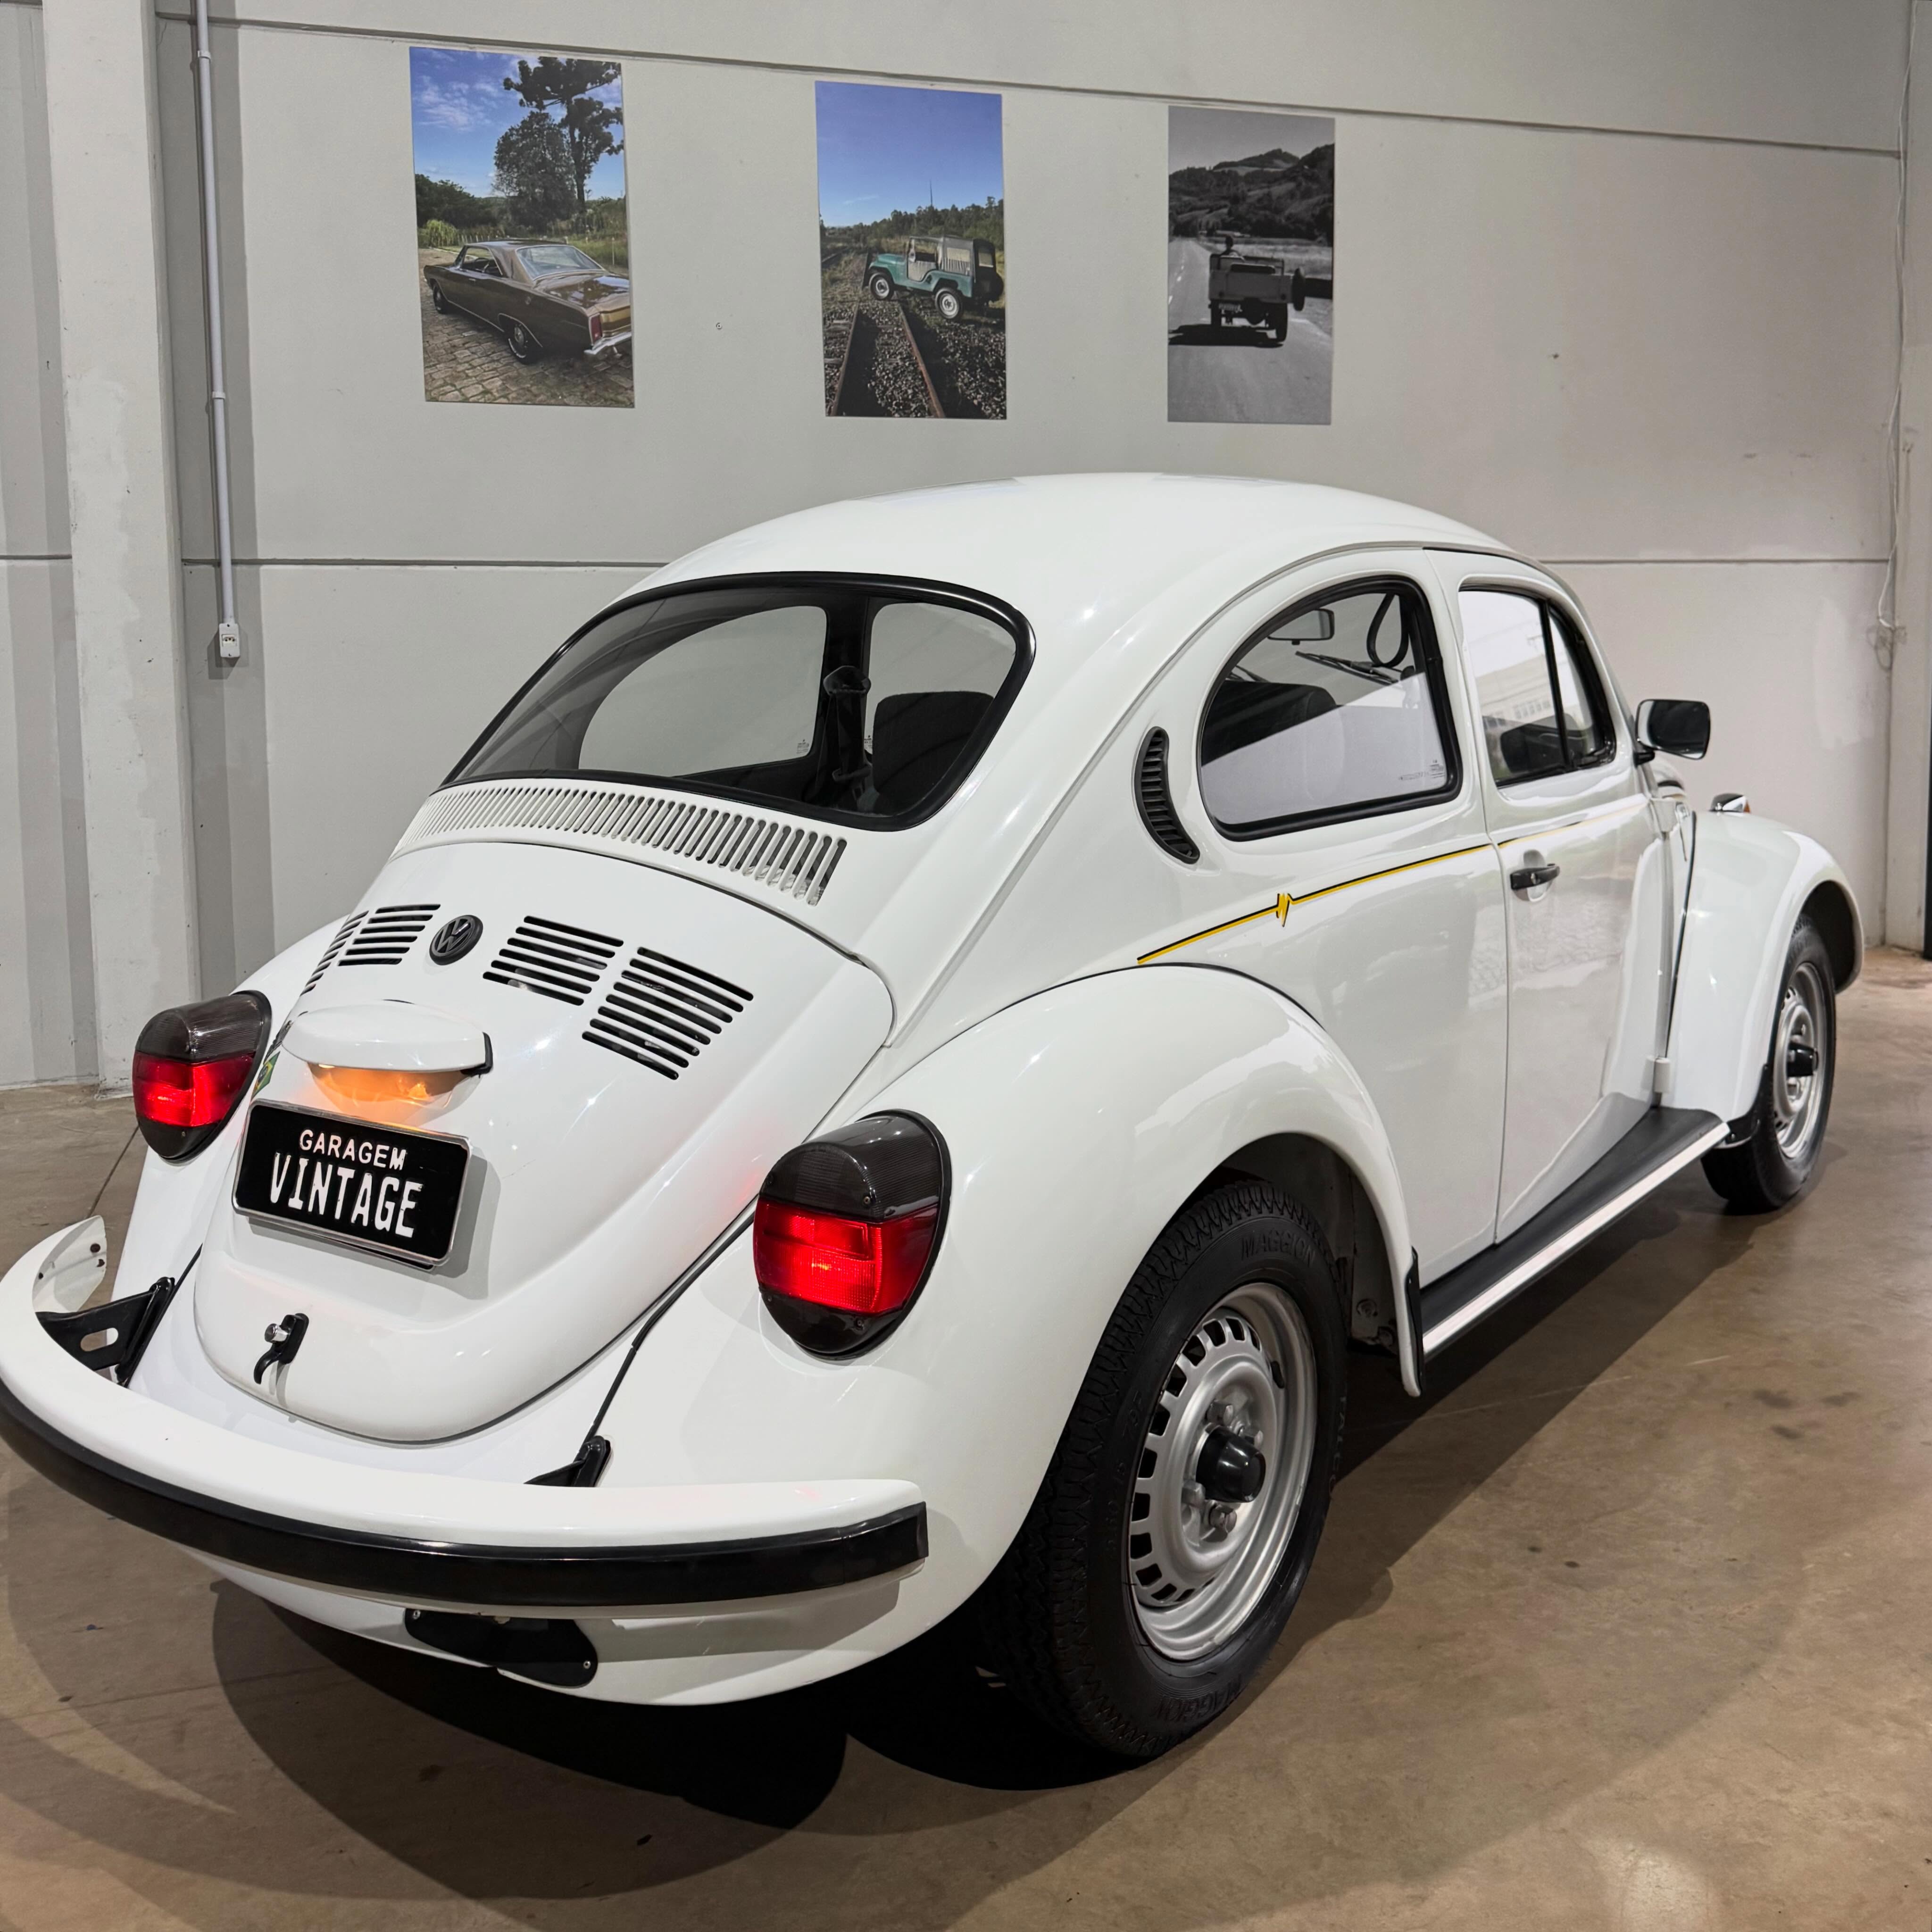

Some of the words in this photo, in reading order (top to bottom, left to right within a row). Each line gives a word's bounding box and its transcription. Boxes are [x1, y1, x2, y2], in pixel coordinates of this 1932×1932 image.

[300, 1129, 408, 1170] GARAGEM
[270, 1151, 424, 1238] VINTAGE
[1241, 1229, 1316, 1267] MAGGION
